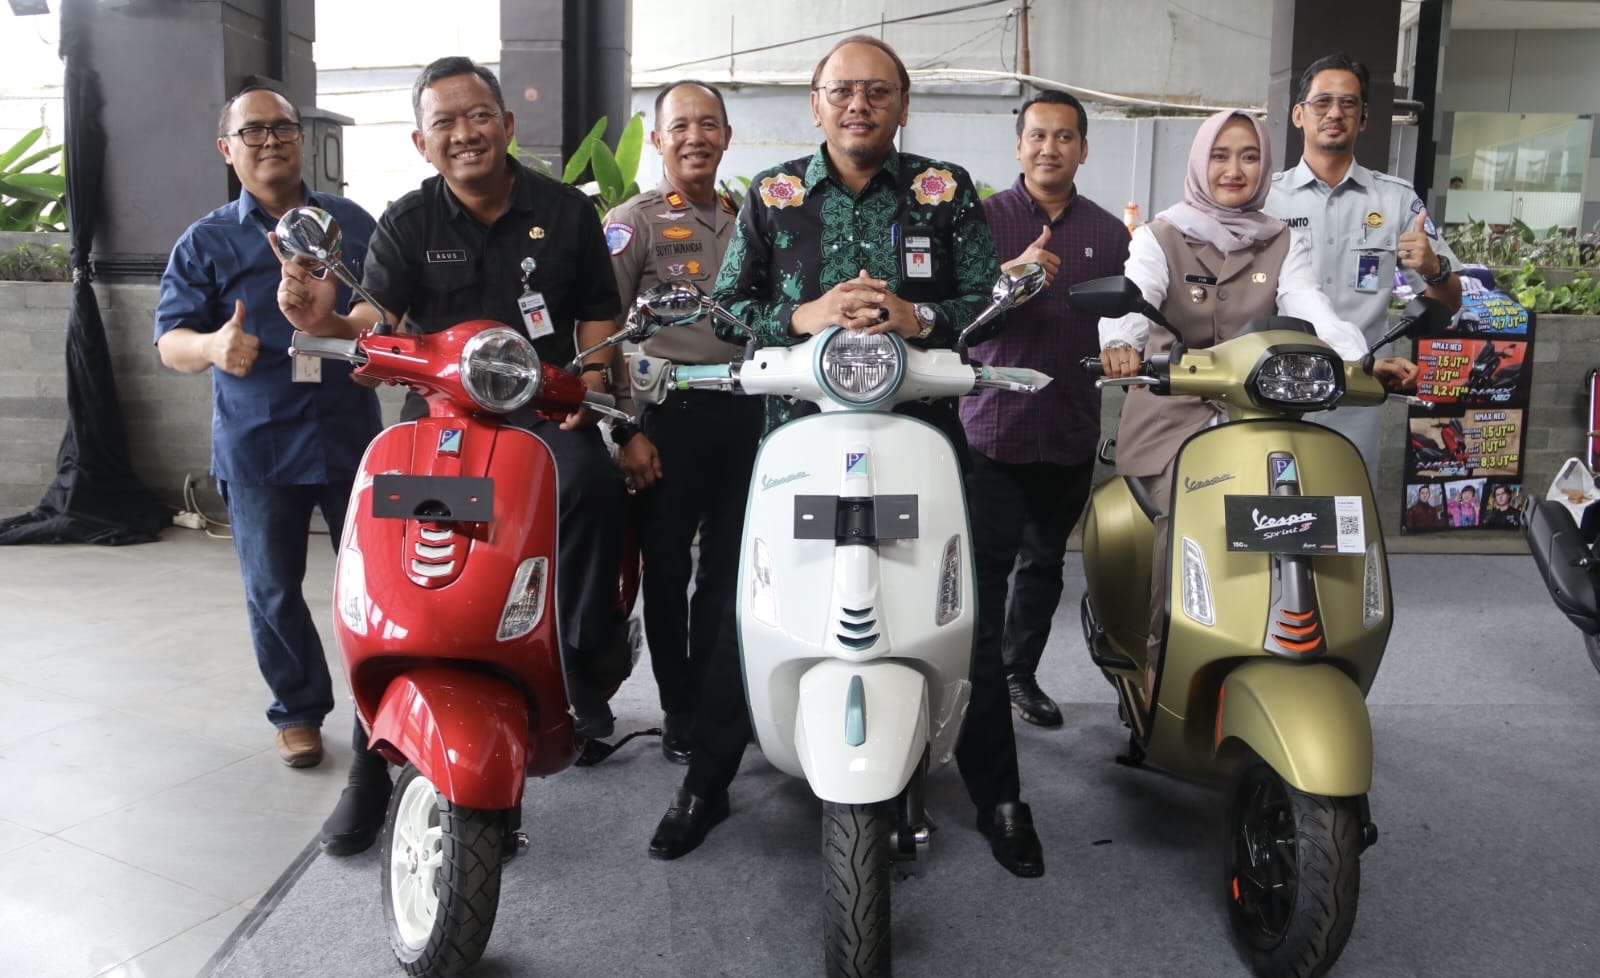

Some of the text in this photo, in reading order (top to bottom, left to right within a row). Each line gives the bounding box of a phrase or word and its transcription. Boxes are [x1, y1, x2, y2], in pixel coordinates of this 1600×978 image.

[1432, 341, 1462, 351] NMAX NEO
[1436, 369, 1440, 380] 1
[1432, 384, 1448, 396] 8,2
[1474, 412, 1506, 421] NMAX NEO
[1482, 441, 1486, 453] 1
[1480, 457, 1496, 469] 8,3
[761, 471, 811, 491] Vespa
[1185, 474, 1236, 494] Vespa
[1252, 508, 1317, 531] Vespa
[1263, 526, 1299, 540] Sprint
